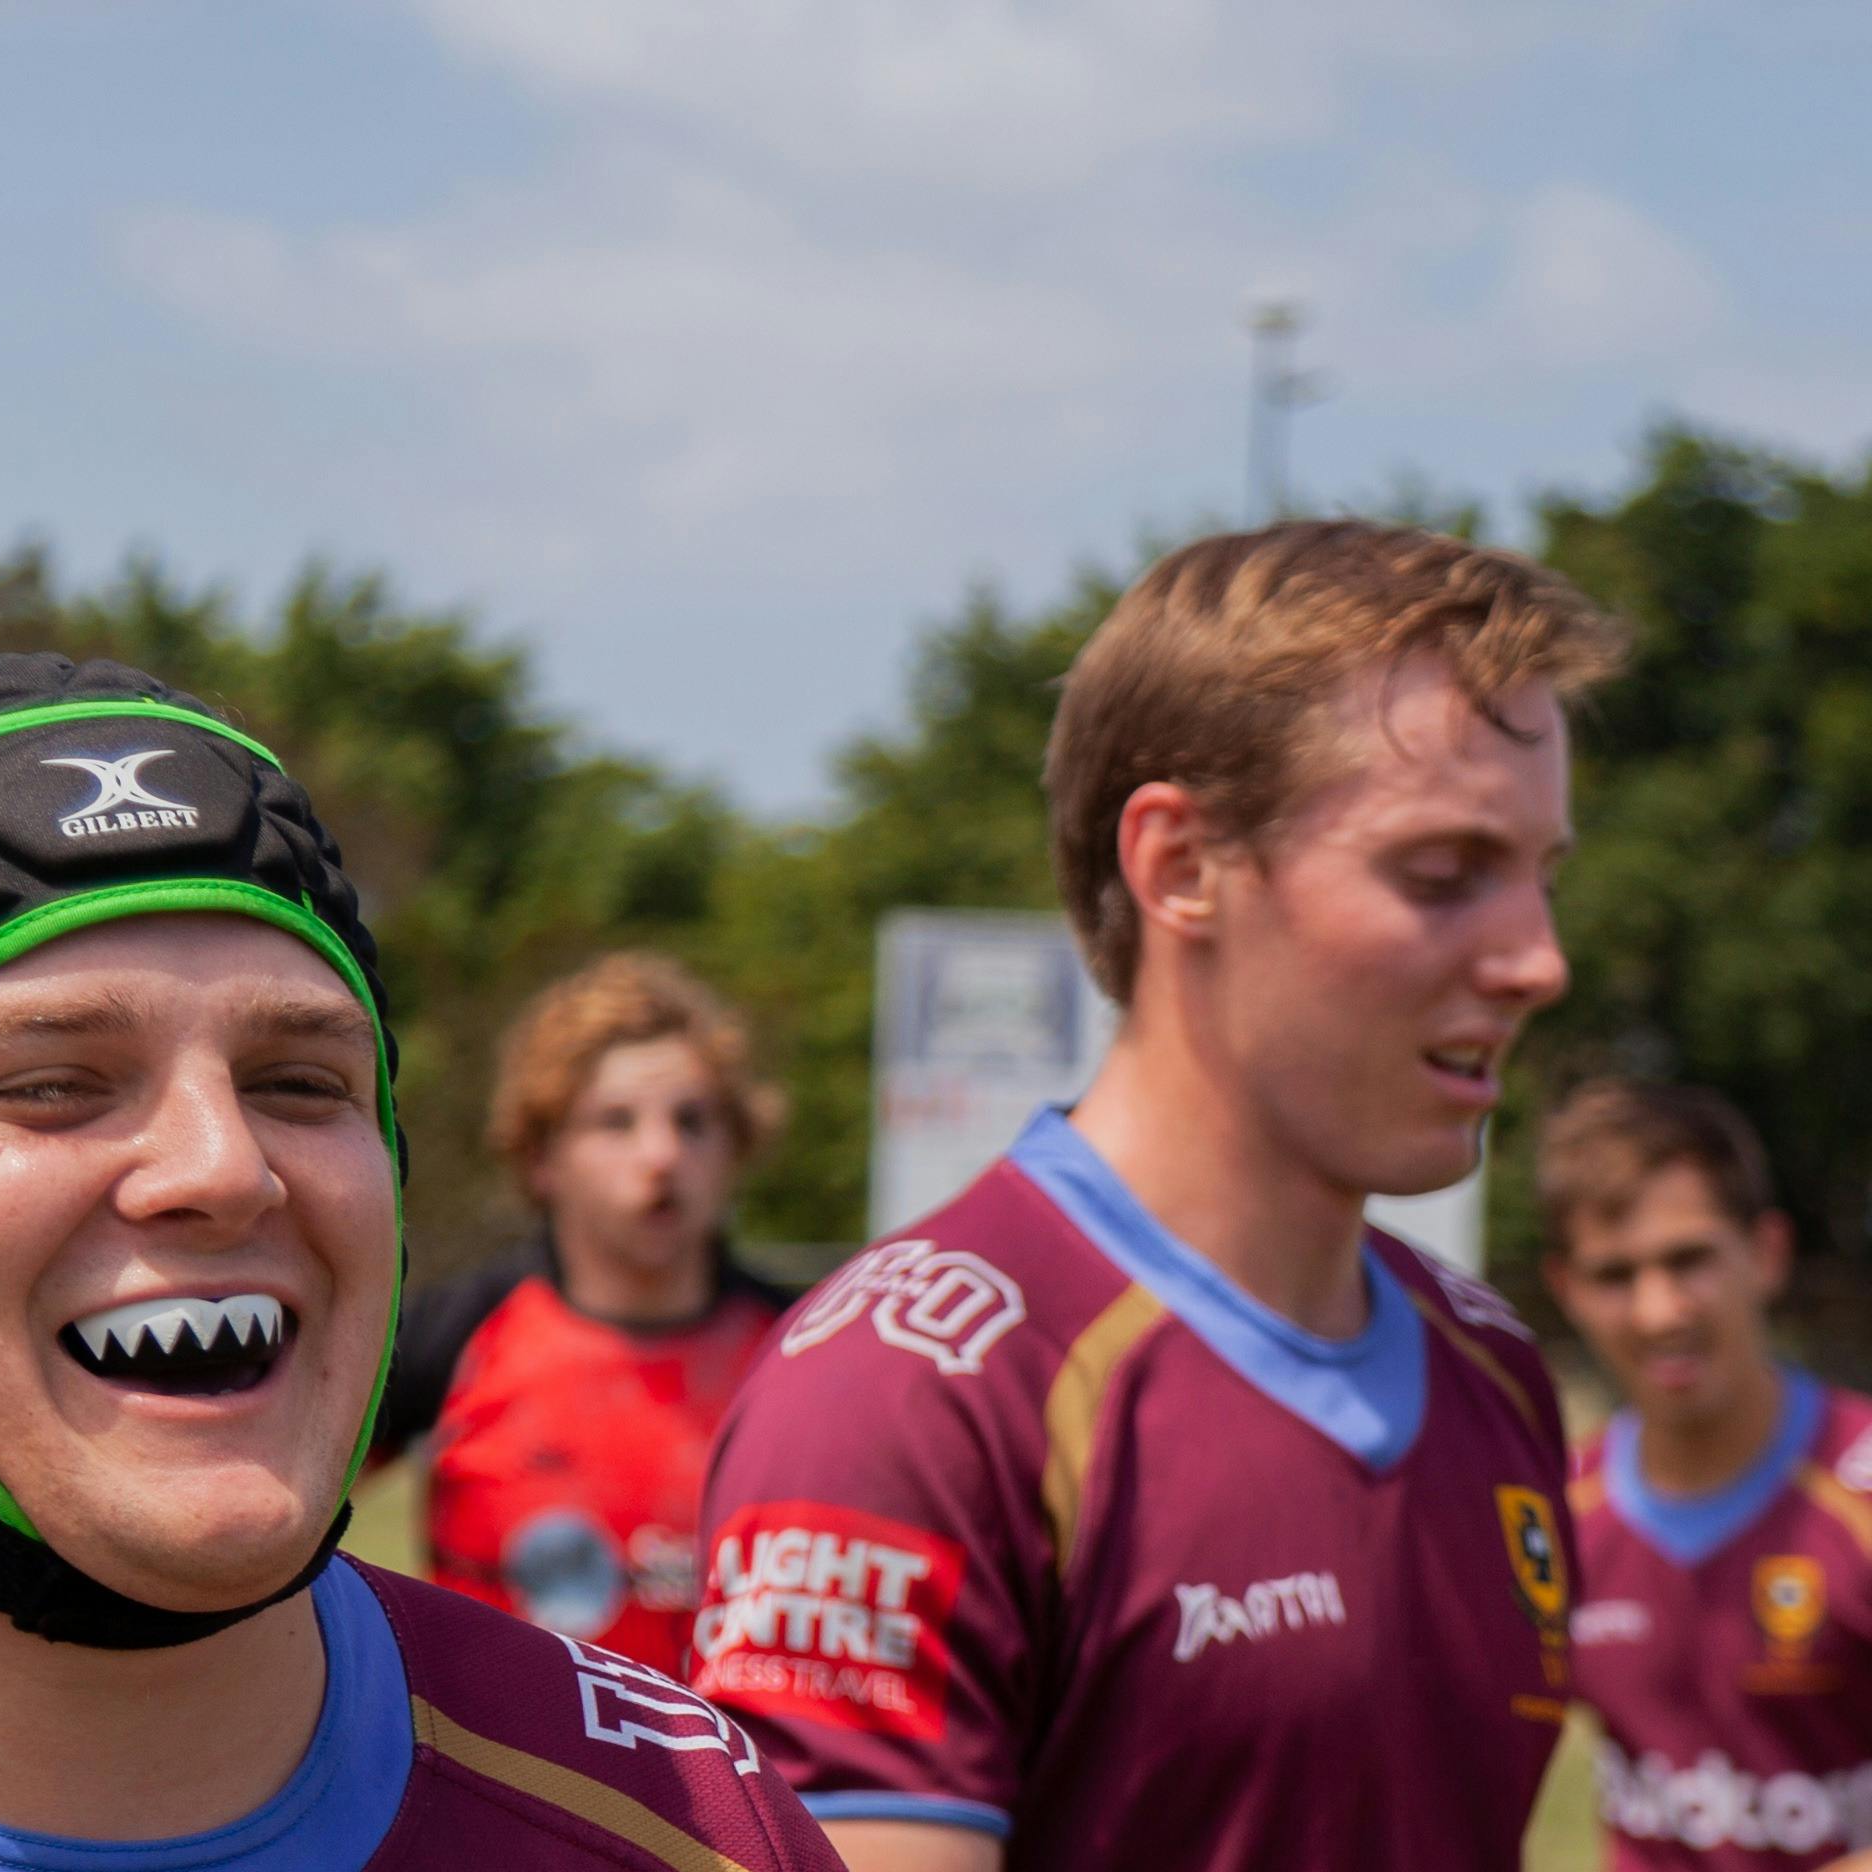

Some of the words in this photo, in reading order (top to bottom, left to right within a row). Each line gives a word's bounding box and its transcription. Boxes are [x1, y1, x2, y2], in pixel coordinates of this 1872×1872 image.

[61, 810, 199, 838] GILBERT
[708, 1527, 931, 1611] LIGHT
[787, 1656, 919, 1716] TRAVEL
